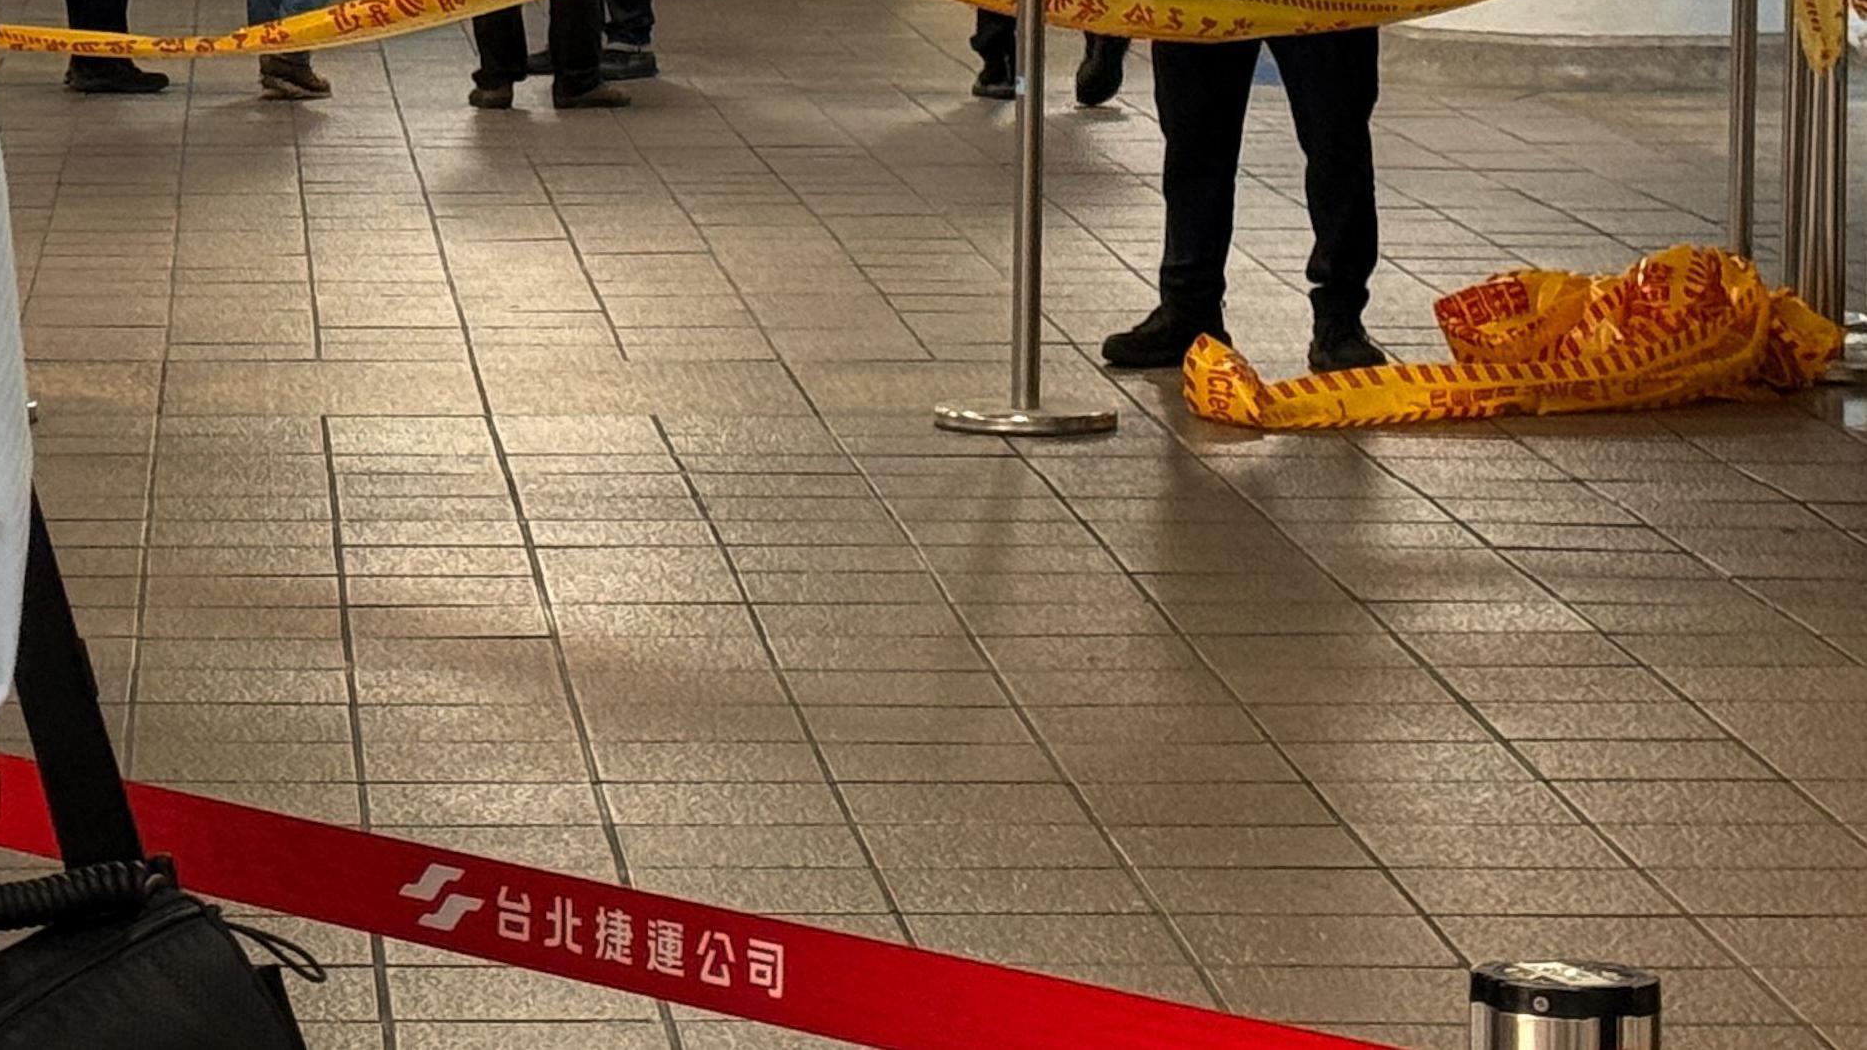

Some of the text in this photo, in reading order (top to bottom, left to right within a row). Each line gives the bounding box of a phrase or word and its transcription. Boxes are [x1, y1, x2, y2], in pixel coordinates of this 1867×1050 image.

[496, 885, 784, 998] 台北捷運公司
